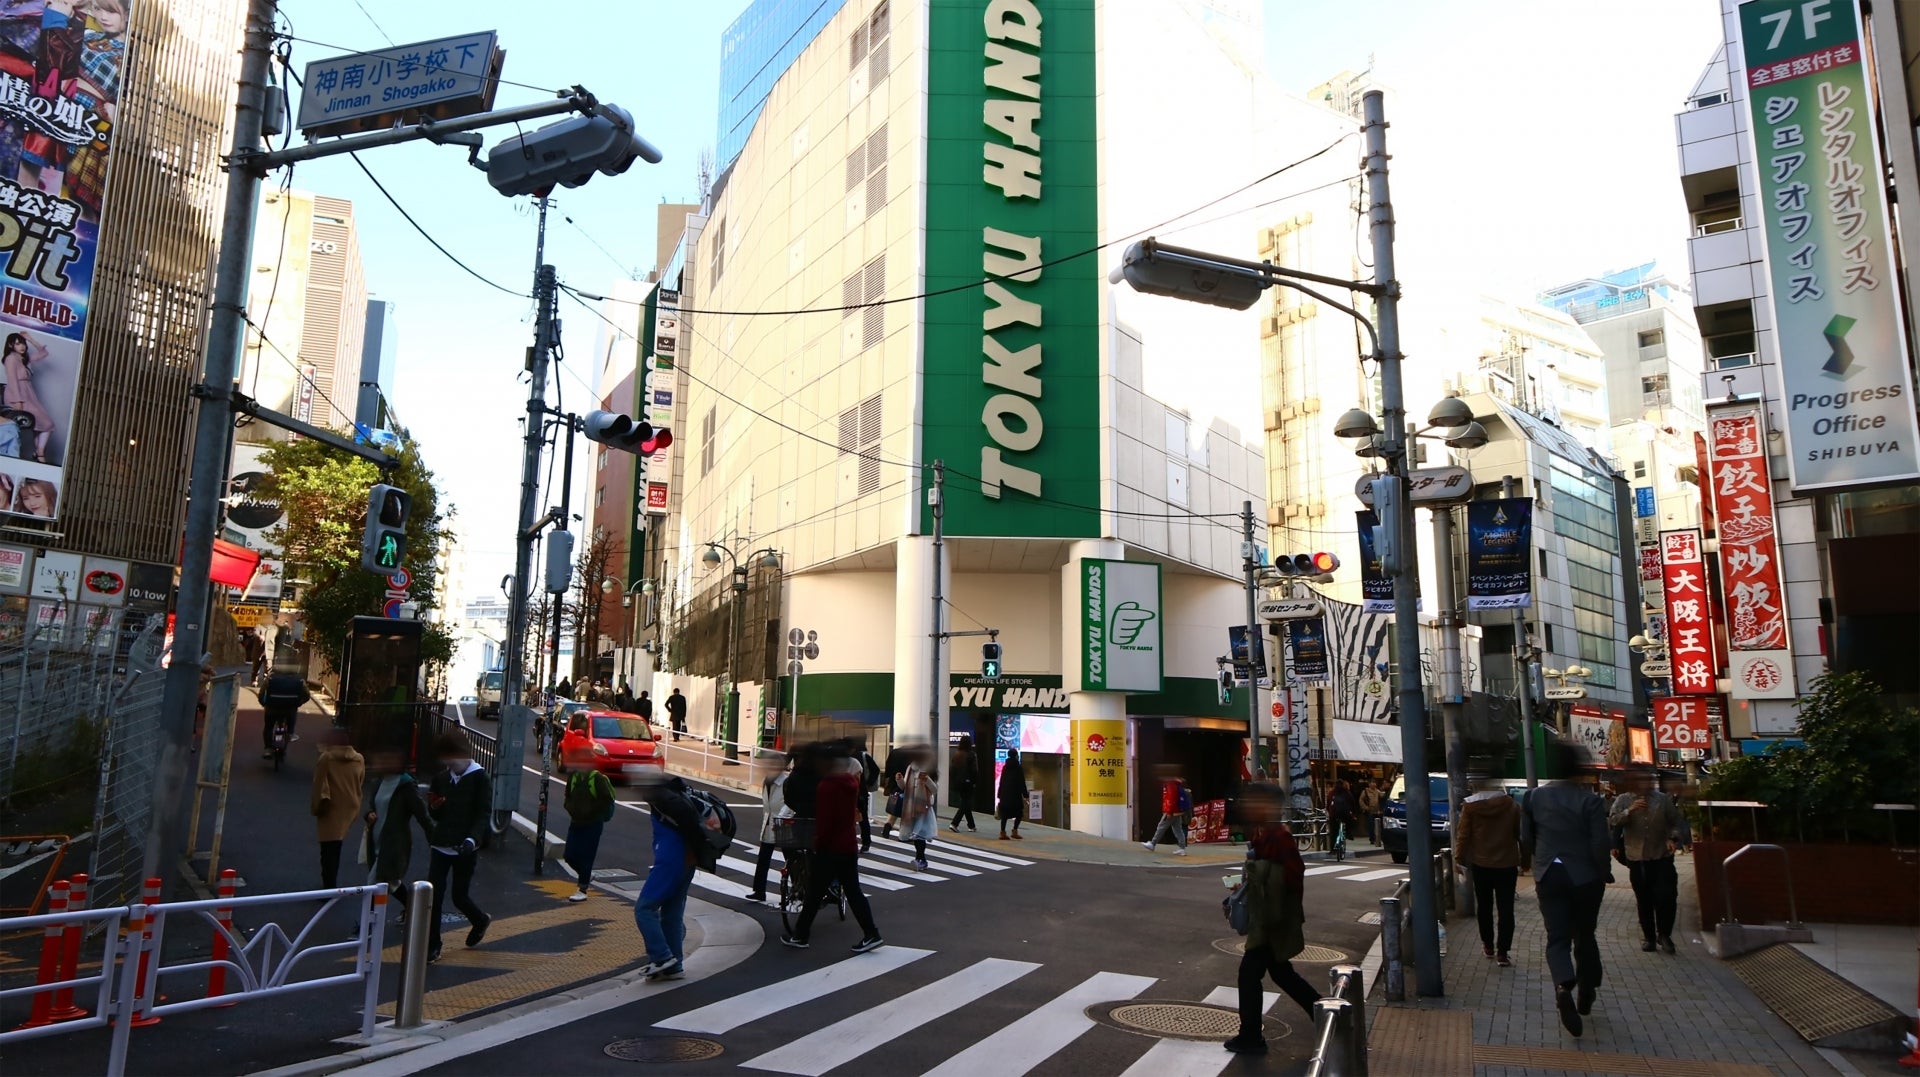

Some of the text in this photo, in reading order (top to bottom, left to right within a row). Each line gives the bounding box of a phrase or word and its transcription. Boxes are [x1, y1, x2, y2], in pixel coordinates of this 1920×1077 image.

[1760, 0, 1832, 50] 7F
[314, 42, 480, 98] 神南小学校下
[1751, 46, 1854, 87] 全室窓付き
[323, 77, 456, 114] Jinnan Shogakko
[1766, 96, 1824, 304] シェアオフィス
[1818, 82, 1879, 295] レンタルオフィス
[982, 225, 1043, 500] TOKYU
[1791, 384, 1902, 411] Progress
[1714, 416, 1755, 441] 餃子
[1812, 414, 1887, 436] Office
[1716, 440, 1758, 456] 一番
[1807, 440, 1901, 462] SHIBUYA
[1715, 463, 1767, 523] 餃子
[1666, 533, 1695, 549] 餃子
[1667, 549, 1695, 560] 一番
[1727, 545, 1780, 613] 炒飯
[1260, 603, 1316, 613] 渋谷センター街
[1088, 565, 1102, 684] TOKYU HANDS
[1668, 569, 1711, 689] 大阪王将
[1755, 668, 1769, 689] 王将
[1664, 702, 1696, 722] 2F
[1086, 758, 1124, 767] TAX FREE
[1099, 768, 1115, 778] 免税
